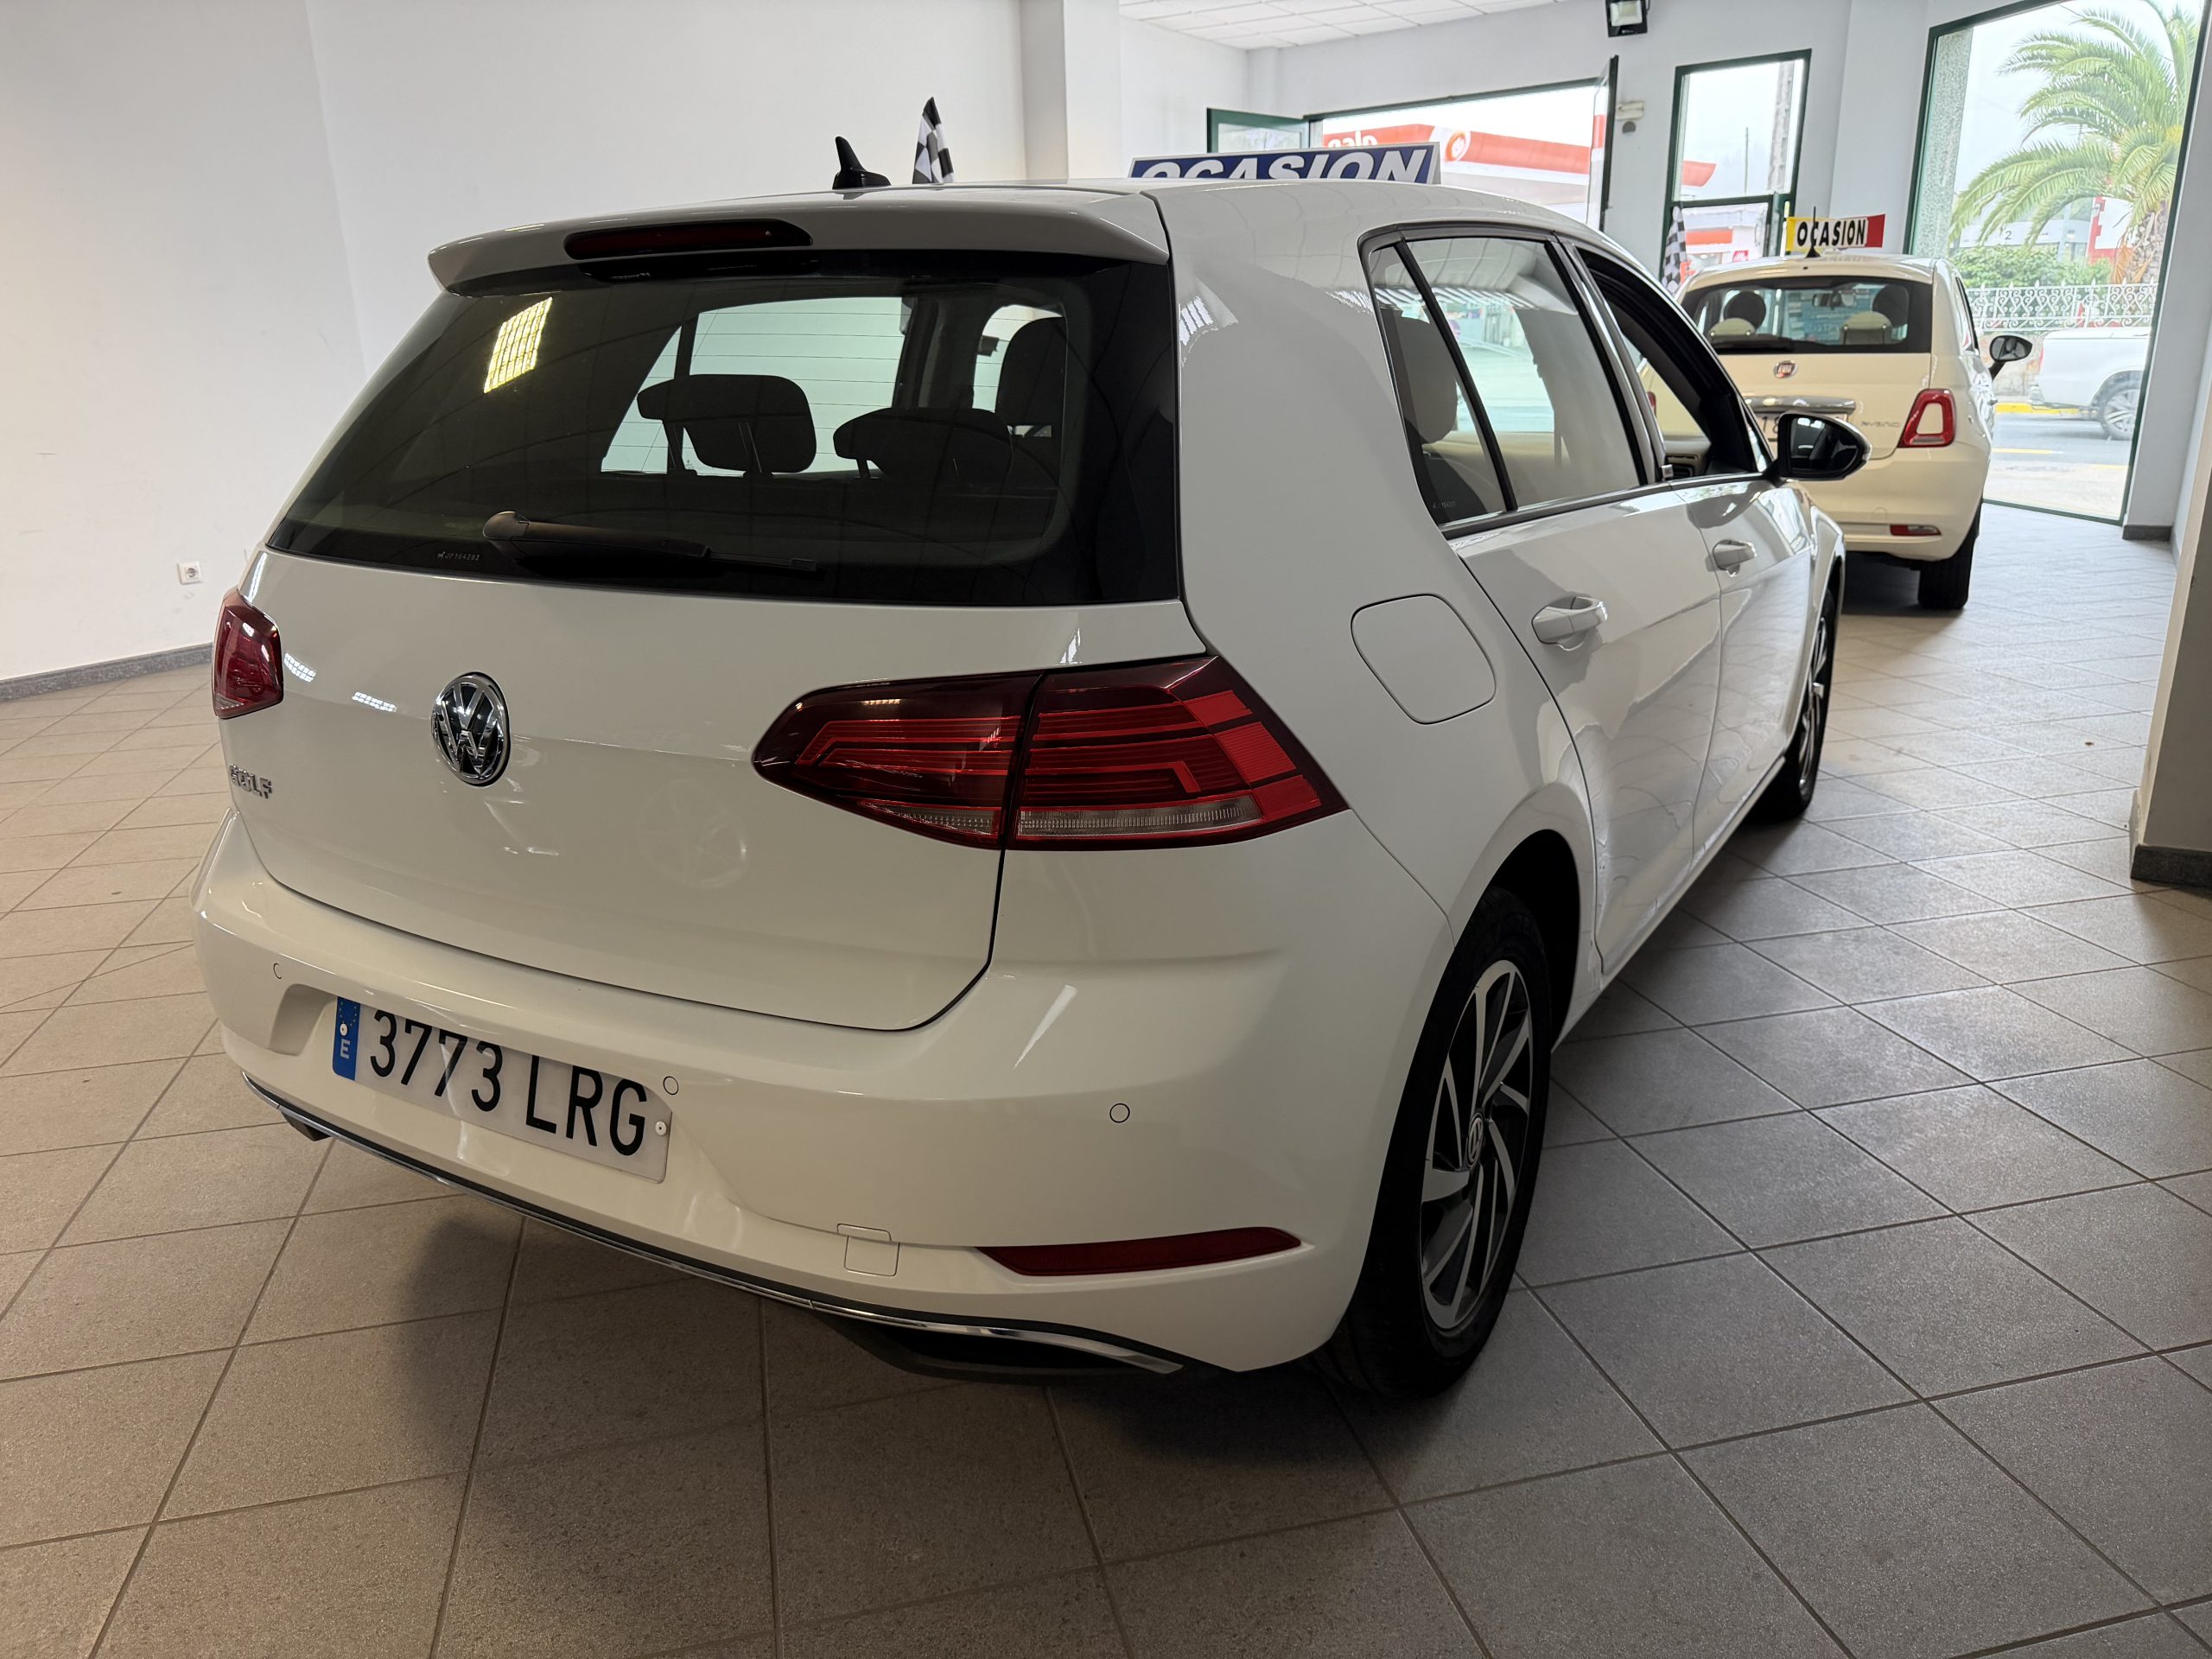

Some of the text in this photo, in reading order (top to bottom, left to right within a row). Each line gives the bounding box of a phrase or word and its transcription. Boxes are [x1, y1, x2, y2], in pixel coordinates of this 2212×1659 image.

[1796, 219, 1866, 247] OCASION
[229, 764, 272, 799] GOLF
[340, 1039, 351, 1060] E
[370, 1009, 648, 1157] 3773 LRG
